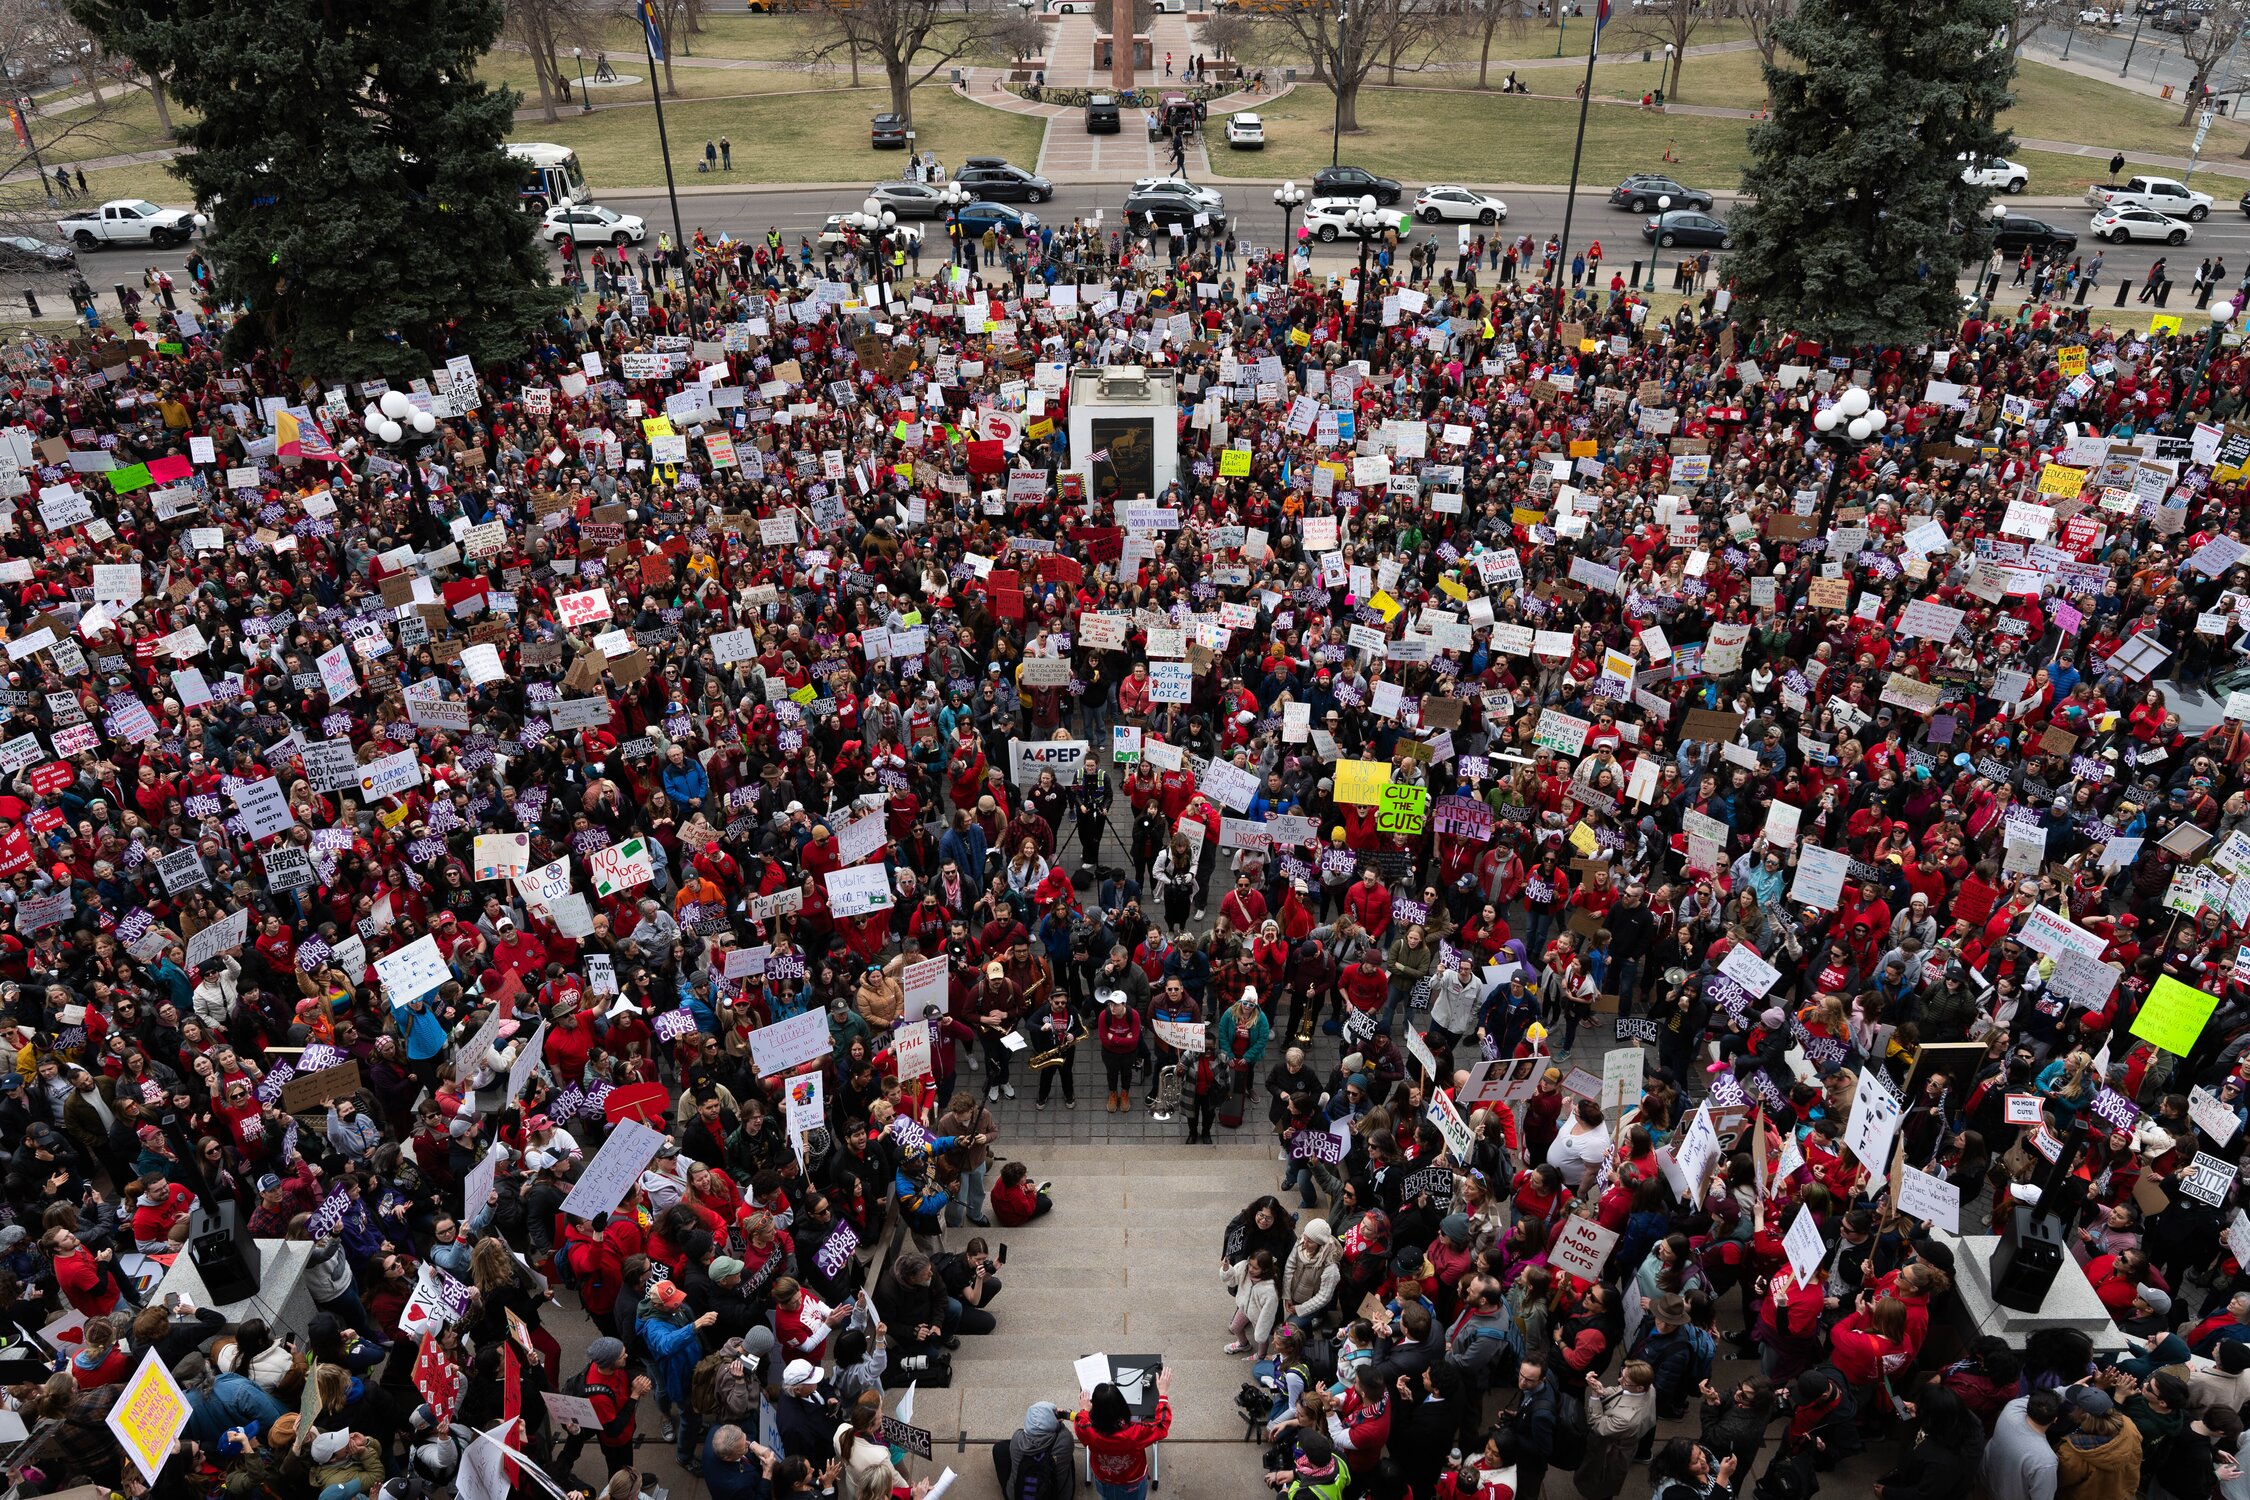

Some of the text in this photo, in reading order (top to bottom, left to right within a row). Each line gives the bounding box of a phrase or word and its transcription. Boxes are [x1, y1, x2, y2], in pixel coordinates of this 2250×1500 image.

[2064, 347, 2083, 355] FUND
[2060, 361, 2083, 370] FUTURE
[446, 384, 475, 398] RAGE
[525, 390, 547, 400] FUND
[450, 398, 481, 416] MACHINE
[1225, 452, 1248, 460] FUND
[42, 497, 78, 514] Education
[60, 504, 78, 514] CUTS
[64, 512, 88, 524] HEAL
[1129, 519, 1146, 527] GOOD
[2006, 508, 2050, 526] EDUCATION
[582, 526, 624, 534] EDUCATION
[1684, 524, 1698, 534] NO
[2017, 527, 2032, 536] ALL
[2068, 526, 2095, 536] TEACHER
[1673, 536, 1696, 544] IDEA
[2068, 532, 2088, 542] VOICE
[480, 545, 500, 556] FUND
[2066, 542, 2079, 550] CUT
[1485, 558, 1516, 572] FAILING
[1483, 571, 1508, 584] Colorado
[2080, 580, 2102, 589] MORE
[560, 596, 595, 612] FUND
[401, 618, 422, 628] FUND
[568, 610, 610, 626] FUTURE
[716, 632, 744, 644] A CUT
[730, 648, 750, 657] CUT
[55, 692, 78, 704] FUND
[1152, 690, 1188, 700] VOICE
[414, 701, 467, 714] EDUCATION
[420, 710, 467, 723] MATTERS
[1542, 710, 1590, 730] ONLY EDUCATION
[1537, 719, 1584, 740] CAN SAVE US
[1536, 728, 1580, 746] FROM THIS
[1542, 736, 1575, 754] MESS
[304, 757, 322, 766] High
[1022, 748, 1080, 762] A4PEP
[2084, 758, 2096, 766] NO
[326, 764, 355, 774] Arkansas
[374, 756, 400, 772] FUND
[1351, 760, 1376, 775] FUND
[2080, 762, 2104, 776] MORE
[2071, 766, 2102, 782] CUTS!
[329, 776, 358, 790] Colorado
[376, 775, 412, 796] FUTURE!
[248, 786, 265, 796] OUR
[1384, 786, 1424, 800] CUT
[242, 792, 279, 808] CHILDREN
[1392, 802, 1414, 812] THE
[256, 805, 272, 815] ARE
[254, 812, 283, 825] WORTH
[1282, 818, 1296, 826] NO
[1379, 812, 1423, 831] CUTS
[1444, 818, 1485, 840] HEAL
[6, 829, 21, 846] KIDS
[318, 840, 352, 850] CUTS!
[5, 850, 12, 858] A
[266, 849, 300, 863] TABOR
[594, 848, 618, 872] NO
[1329, 856, 1354, 864] MORE
[2226, 846, 2244, 860] KIDS
[162, 853, 192, 869] DEMAND
[164, 860, 198, 876] MEDICAID
[266, 857, 306, 873] STEALS
[1322, 862, 1354, 872] CUTS!
[177, 869, 199, 881] PUBLIC
[278, 870, 300, 880] FROM
[606, 862, 640, 882] More
[620, 869, 650, 888] CUTS
[272, 874, 311, 889] STUDENTS
[520, 876, 540, 893] NO
[542, 877, 568, 898] CUTS
[755, 892, 798, 909] No More
[1404, 900, 1418, 909] NO
[761, 901, 798, 918] CUTS
[1401, 906, 1426, 916] MORE
[1393, 911, 1425, 925] CUTS!
[191, 916, 238, 947] INVEST
[2028, 920, 2086, 954] STEALING
[195, 931, 232, 952] IN THE
[299, 941, 311, 951] NO
[2020, 928, 2051, 953] FROM
[2072, 932, 2102, 952] STOP
[300, 939, 324, 960] MORE
[333, 942, 361, 960] Educate
[302, 944, 332, 972] CUTS!
[585, 956, 614, 971] Fund
[778, 956, 794, 965] NO
[2064, 951, 2106, 975] CUTTING
[767, 968, 804, 980] CUTS!
[775, 962, 804, 972] MORE
[2073, 961, 2094, 976] MORE
[595, 972, 610, 982] MY
[2068, 966, 2095, 984] FUNDS
[2068, 974, 2093, 988] NOT
[2052, 976, 2101, 1003] ANSWER FOR
[665, 1014, 693, 1030] MORE
[666, 1010, 680, 1021] NO
[660, 1021, 697, 1041] CUTS!
[1156, 1021, 1189, 1034] No More
[1617, 1019, 1657, 1030] PROTECT
[1617, 1024, 1656, 1036] PUBLIC
[757, 1030, 779, 1040] Kids
[1617, 1031, 1656, 1042] EDUCATION
[900, 1036, 923, 1053] FAIL
[2110, 1092, 2126, 1107] NO
[2090, 1100, 2133, 1129] CUTS!
[2104, 1098, 2134, 1120] MORE
[1309, 1131, 1327, 1140] NO
[1454, 1122, 1470, 1145] CUT
[1304, 1138, 1339, 1152] MORE
[1292, 1147, 1338, 1165] CUTS!
[2196, 1154, 2235, 1177] STRAIGHT
[1404, 1168, 1451, 1184] PROTECT
[1405, 1175, 1451, 1190] PUBLIC
[2188, 1166, 2230, 1196] OUTTA
[2182, 1181, 2221, 1205] FUNDING!!
[1576, 1226, 1596, 1242] NO
[1563, 1236, 1599, 1260] MORE
[1563, 1251, 1594, 1270] CUTS
[128, 1376, 160, 1424] INJUSTICE
[136, 1392, 165, 1434] ANYWHERE
[883, 1417, 929, 1439] PROTECT
[881, 1422, 929, 1450] PUBLIC
